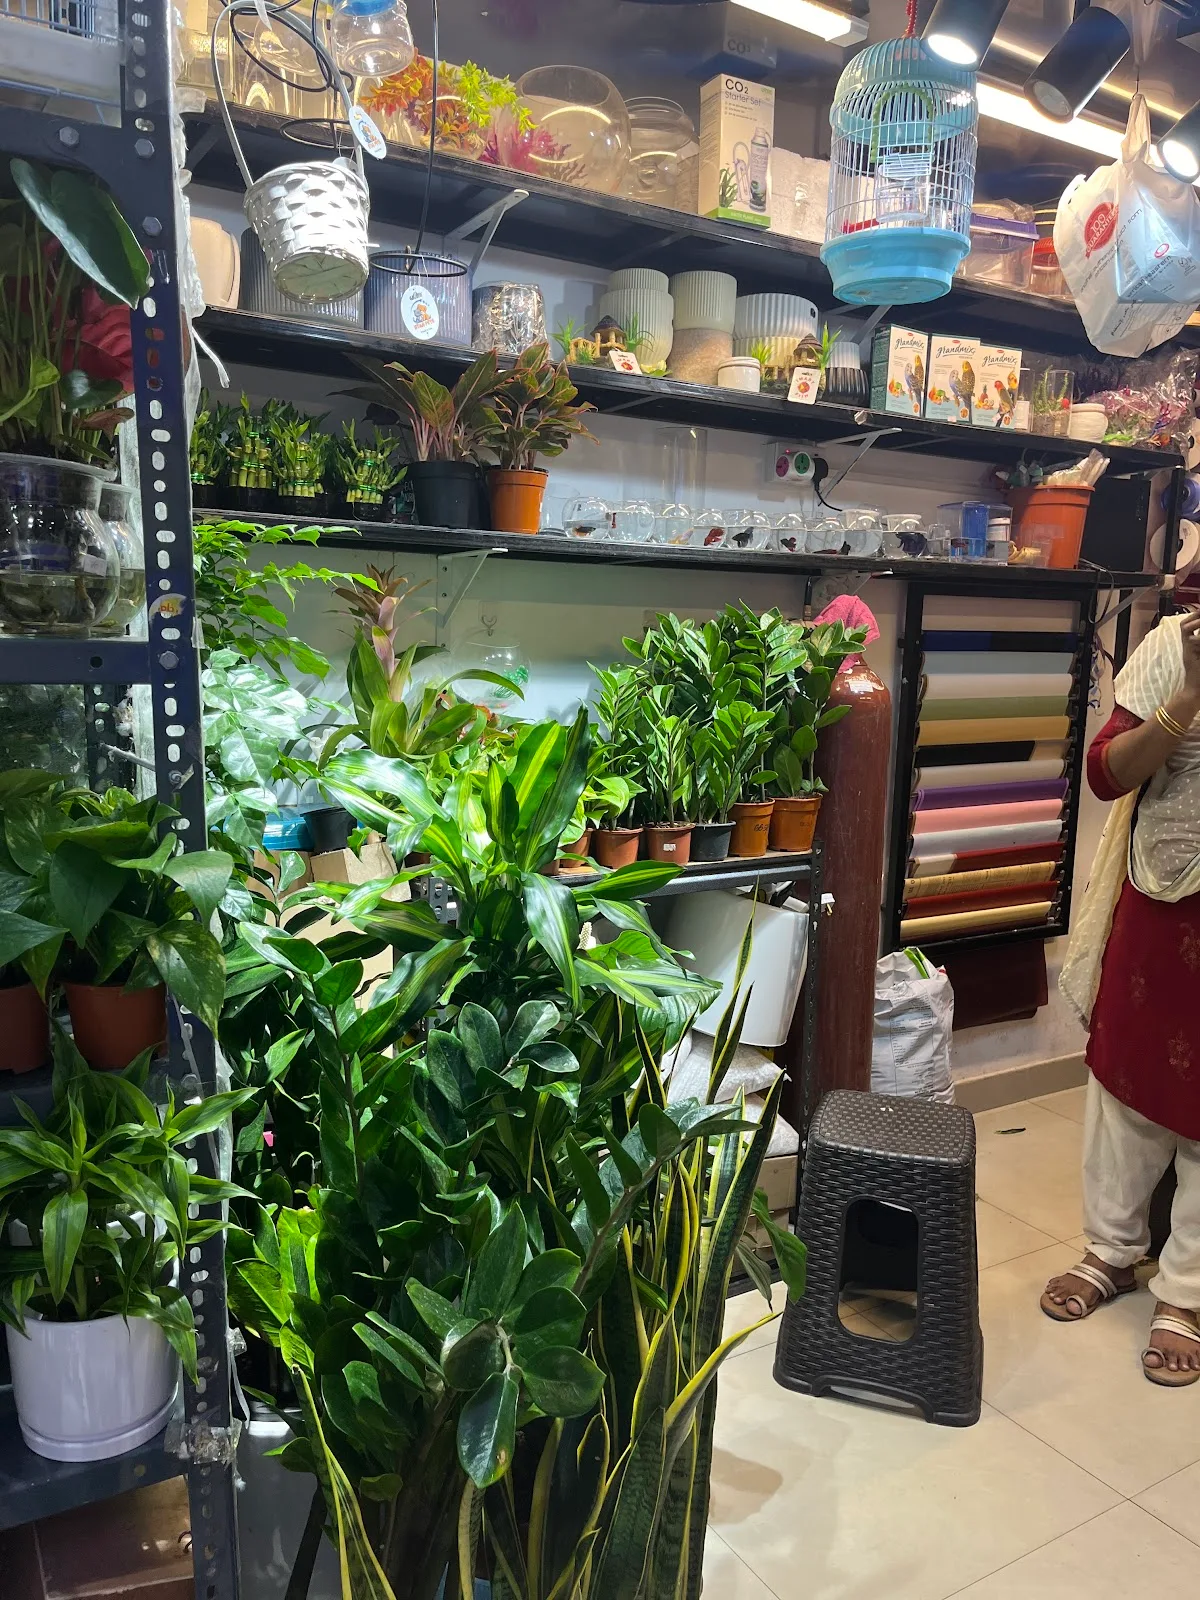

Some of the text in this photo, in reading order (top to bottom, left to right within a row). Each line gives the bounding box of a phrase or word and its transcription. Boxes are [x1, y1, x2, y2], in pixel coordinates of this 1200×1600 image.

[725, 91, 749, 103] Starter
[750, 96, 761, 107] Set
[935, 343, 976, 359] grandmix
[981, 352, 1018, 368] grandmix
